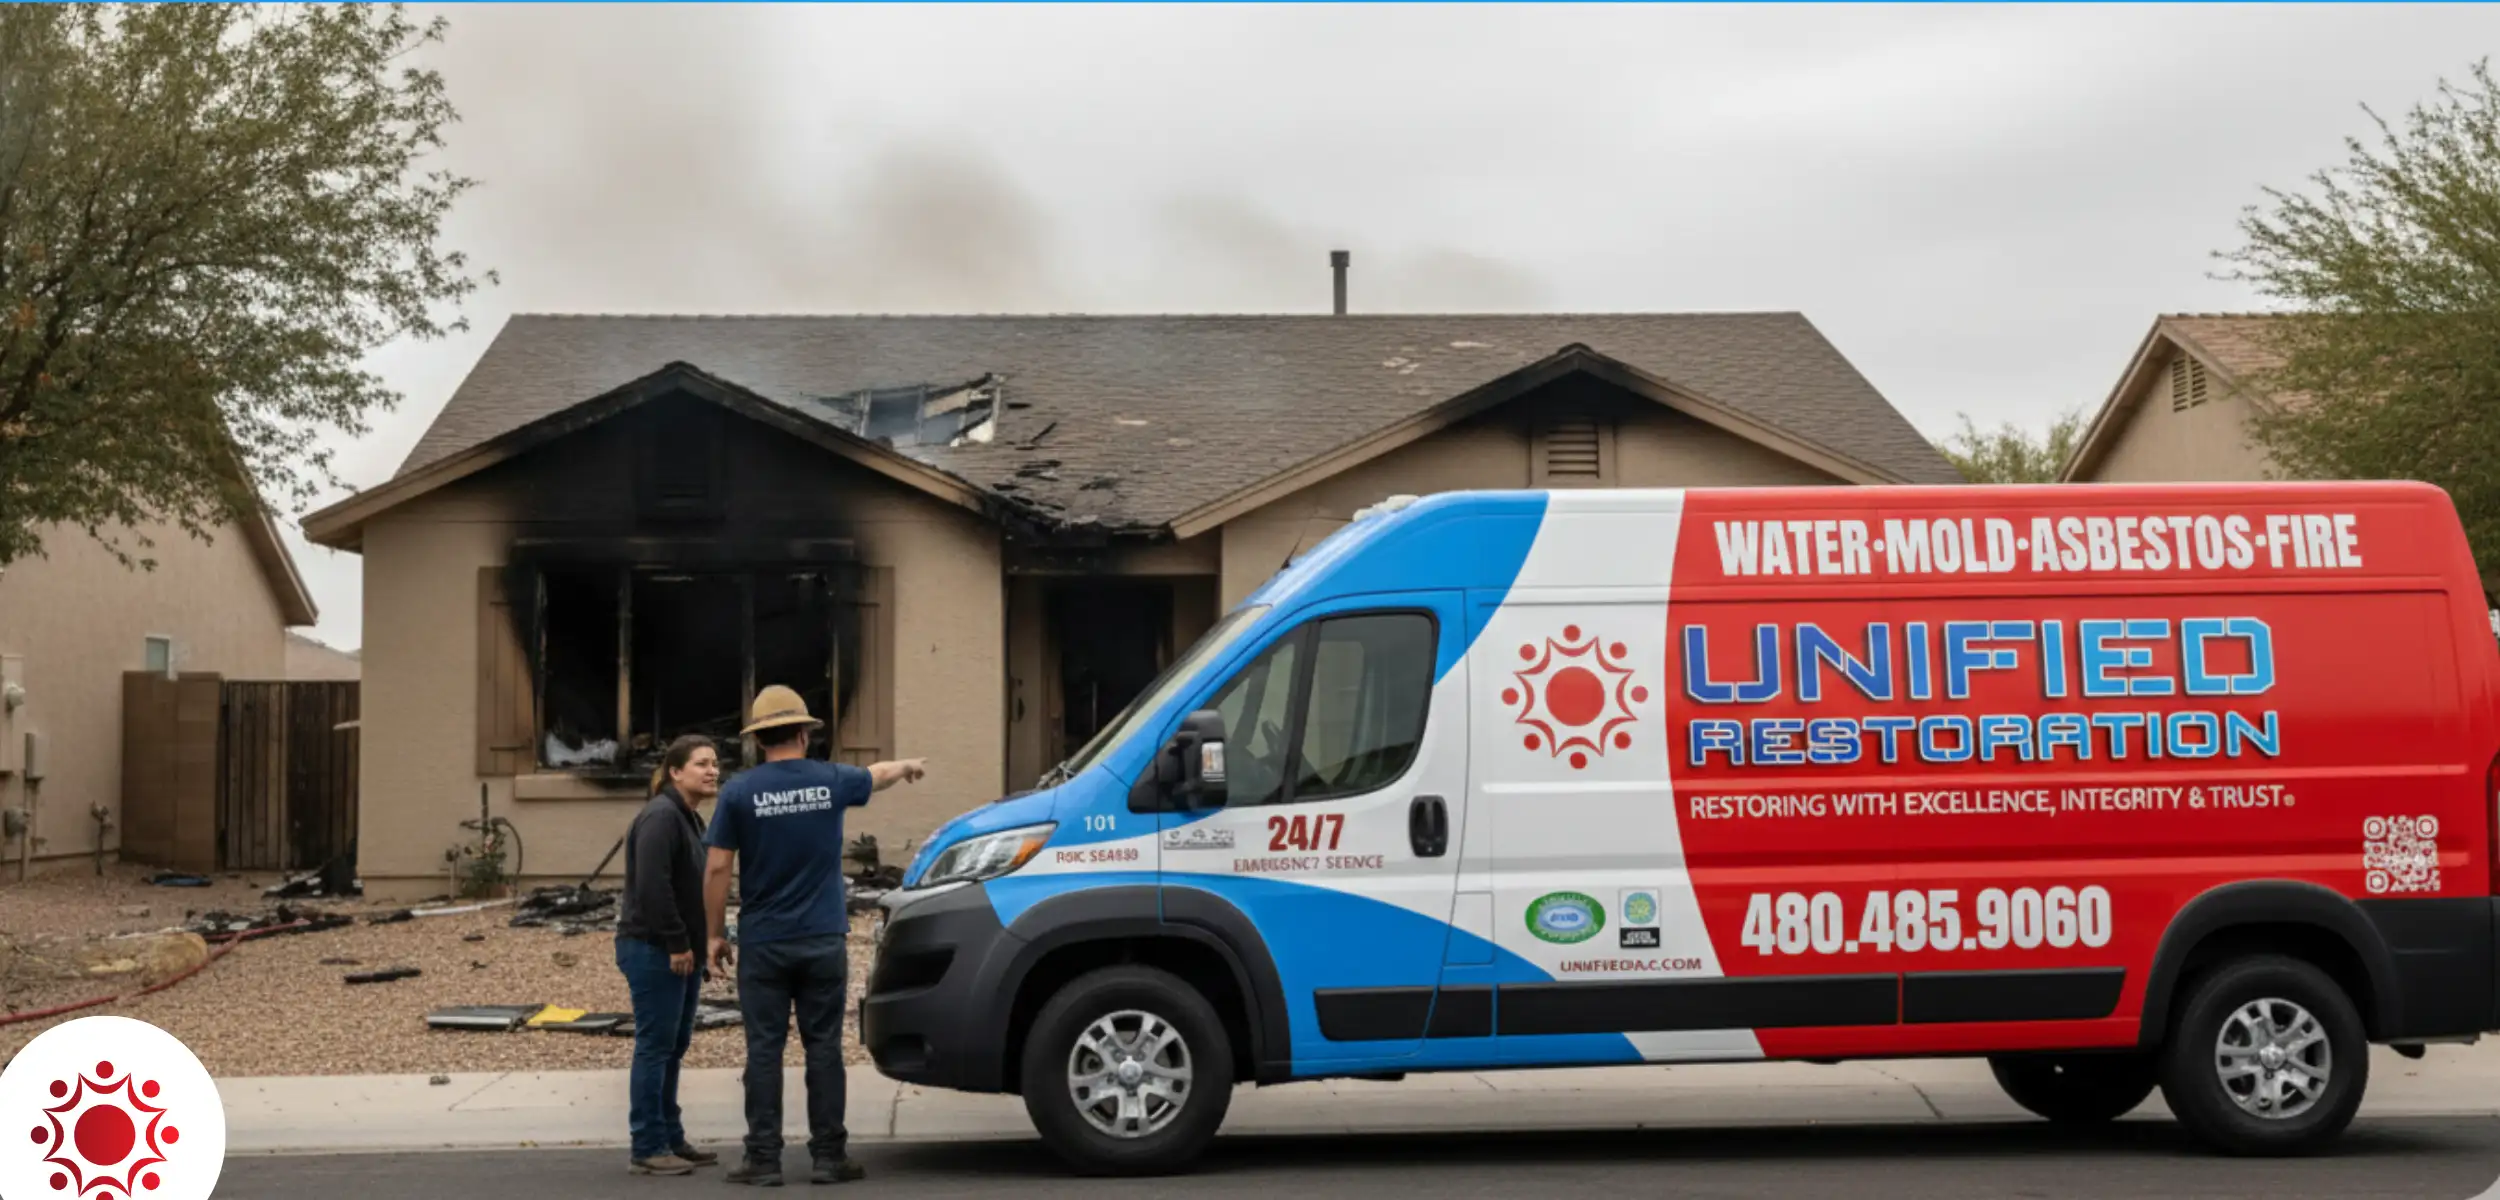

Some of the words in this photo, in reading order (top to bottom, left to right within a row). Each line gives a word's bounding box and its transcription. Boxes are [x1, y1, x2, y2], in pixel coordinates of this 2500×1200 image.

[1714, 520, 1871, 576] WATER
[1883, 518, 2016, 573] MOLD
[2031, 515, 2255, 572] ASBESTOS
[2266, 514, 2363, 568] FIRE
[1683, 617, 2275, 703] UNIFIED
[1690, 710, 2280, 766] RESTORATION
[1084, 815, 1116, 832] 101
[1690, 795, 1827, 819] RESTORING
[1832, 793, 1898, 816] WITH
[1903, 789, 2056, 817] EXCELLENCE,
[2060, 787, 2184, 811] INTEGRITY
[2187, 787, 2206, 808] &
[1268, 813, 1345, 851] 24/7
[1741, 885, 2112, 956] 480.485.9060
